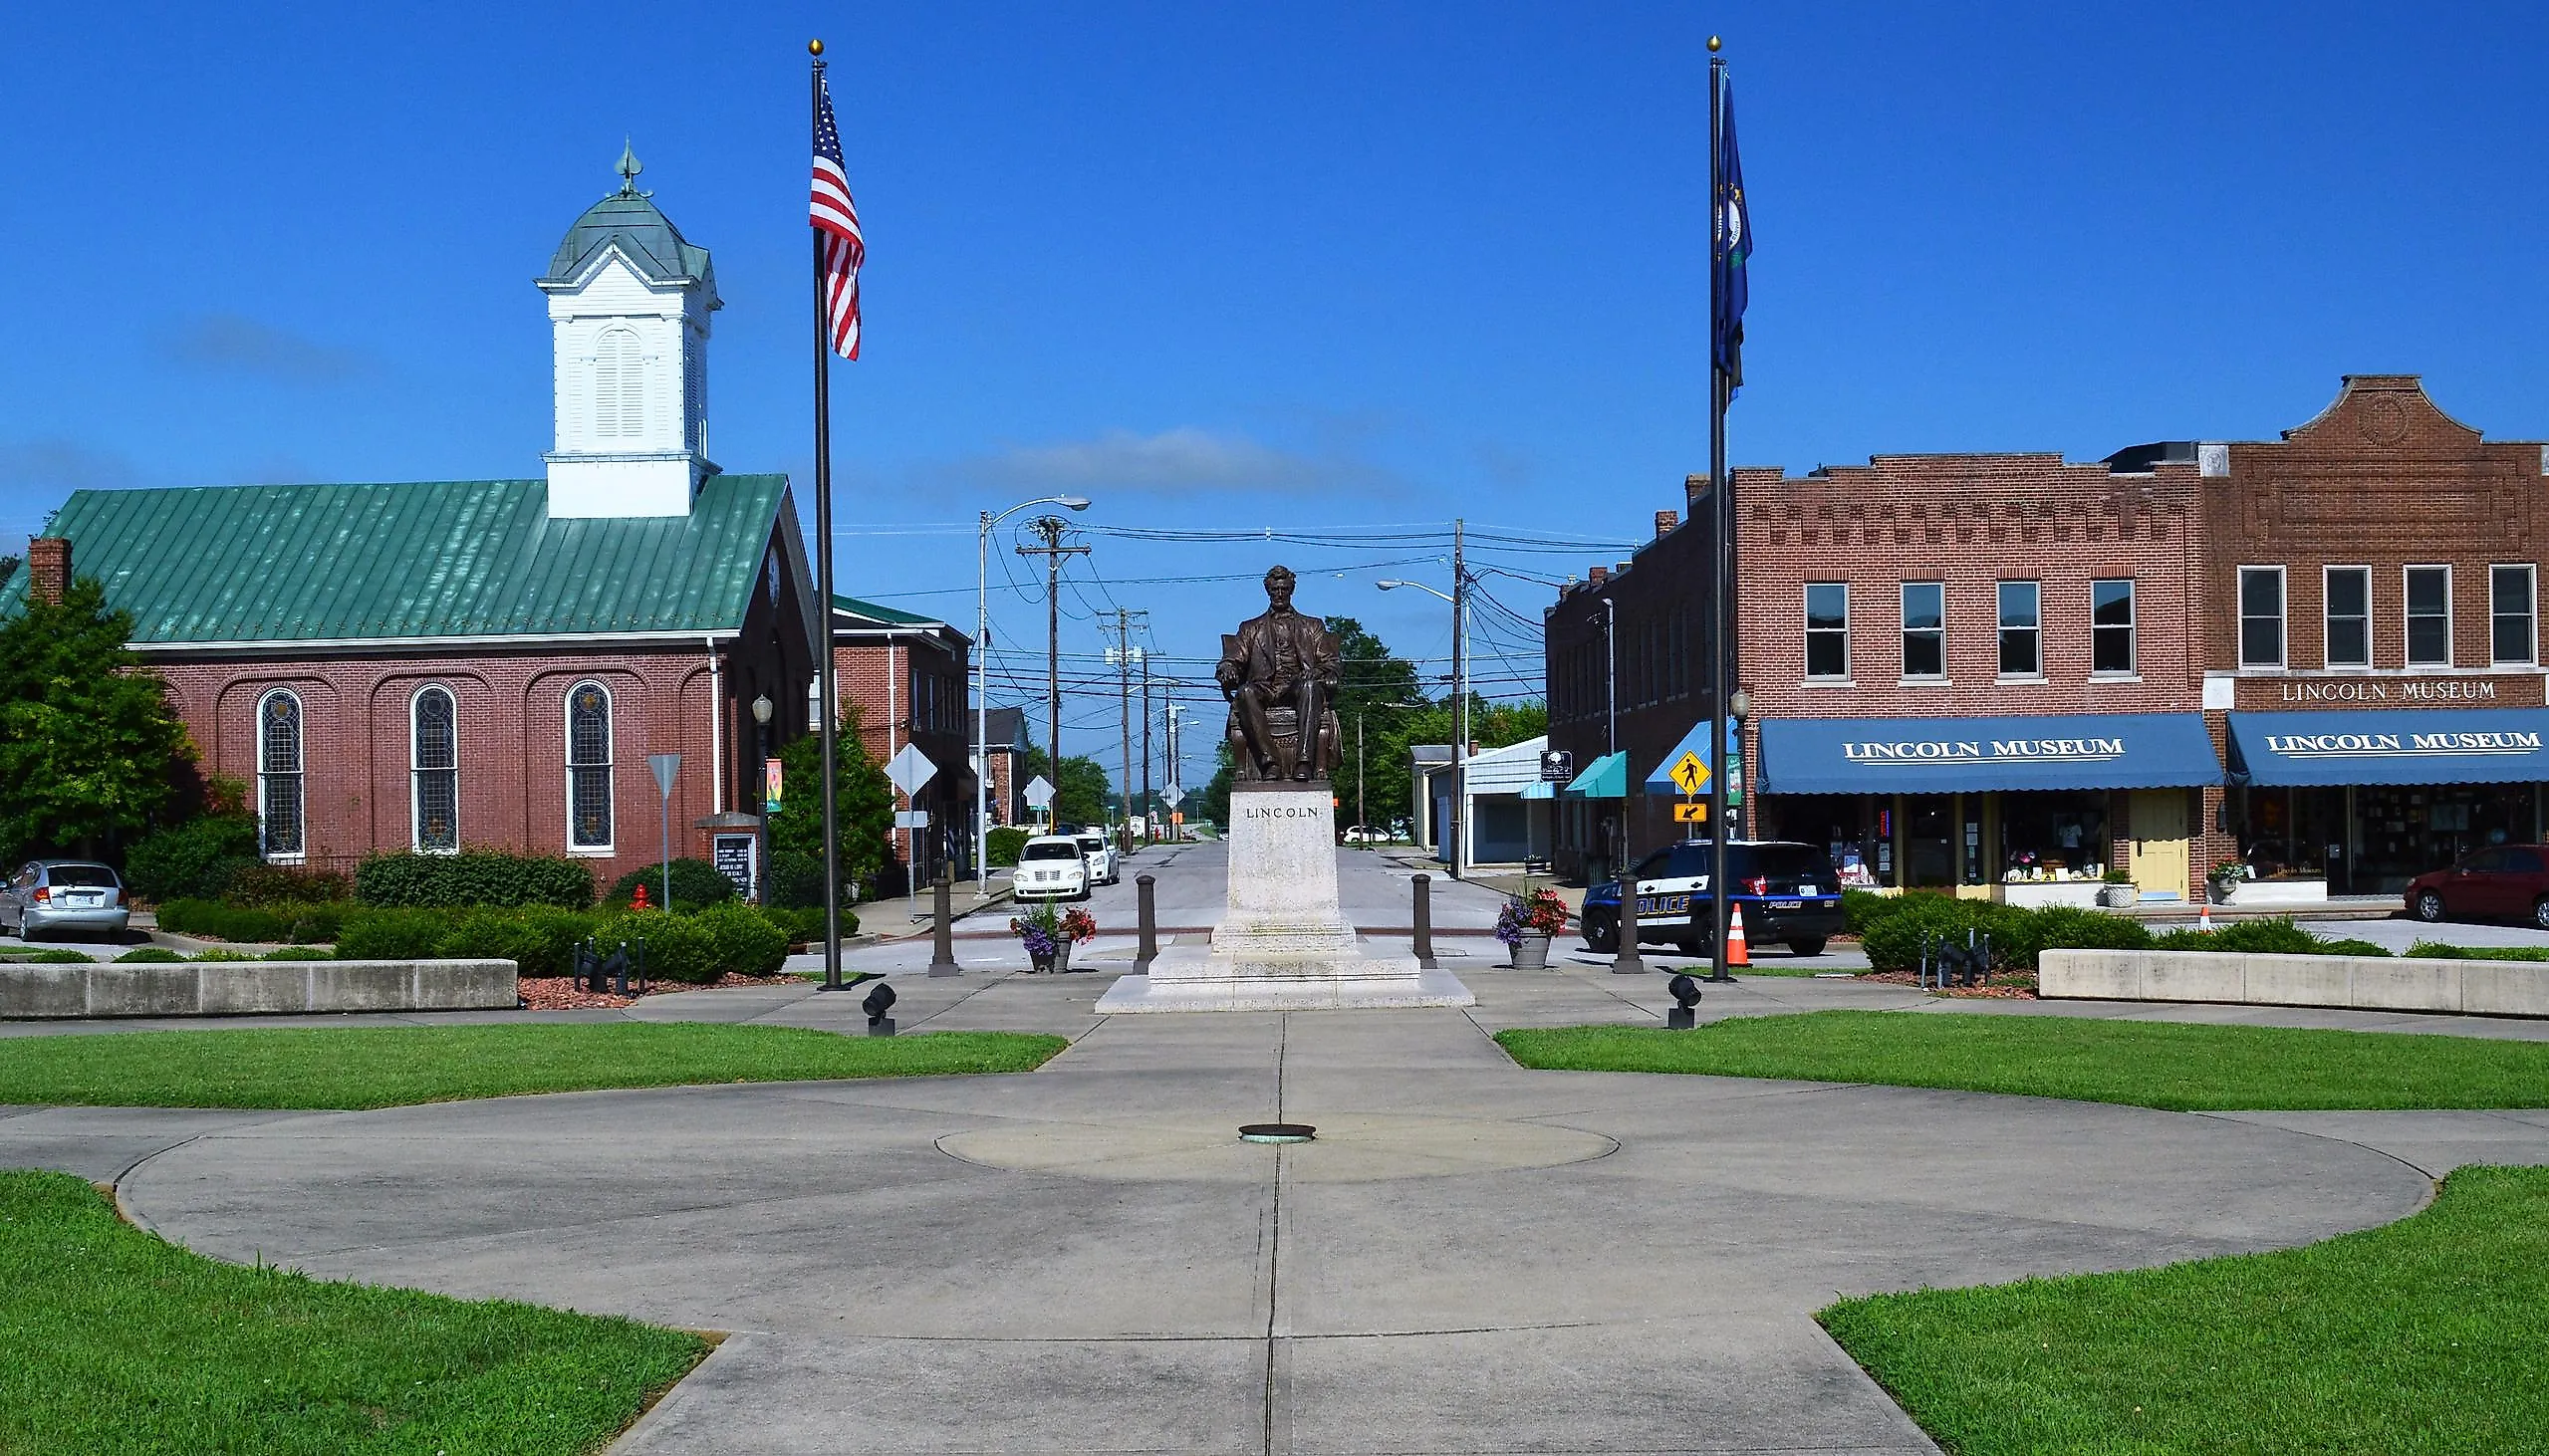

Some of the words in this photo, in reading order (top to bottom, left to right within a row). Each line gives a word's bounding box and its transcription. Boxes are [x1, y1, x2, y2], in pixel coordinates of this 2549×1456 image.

[2282, 683, 2386, 701] LINCOLN
[2402, 681, 2495, 699] MUSEUM
[1841, 741, 1980, 758] LINCOLN
[1990, 738, 2126, 756] MUSEUM
[2264, 734, 2401, 751] LINCOLN
[2410, 732, 2543, 750] MUSEUM
[1246, 807, 1318, 819] LINCOLN
[1636, 894, 1690, 915] OLICE
[1768, 900, 1803, 909] POLICE
